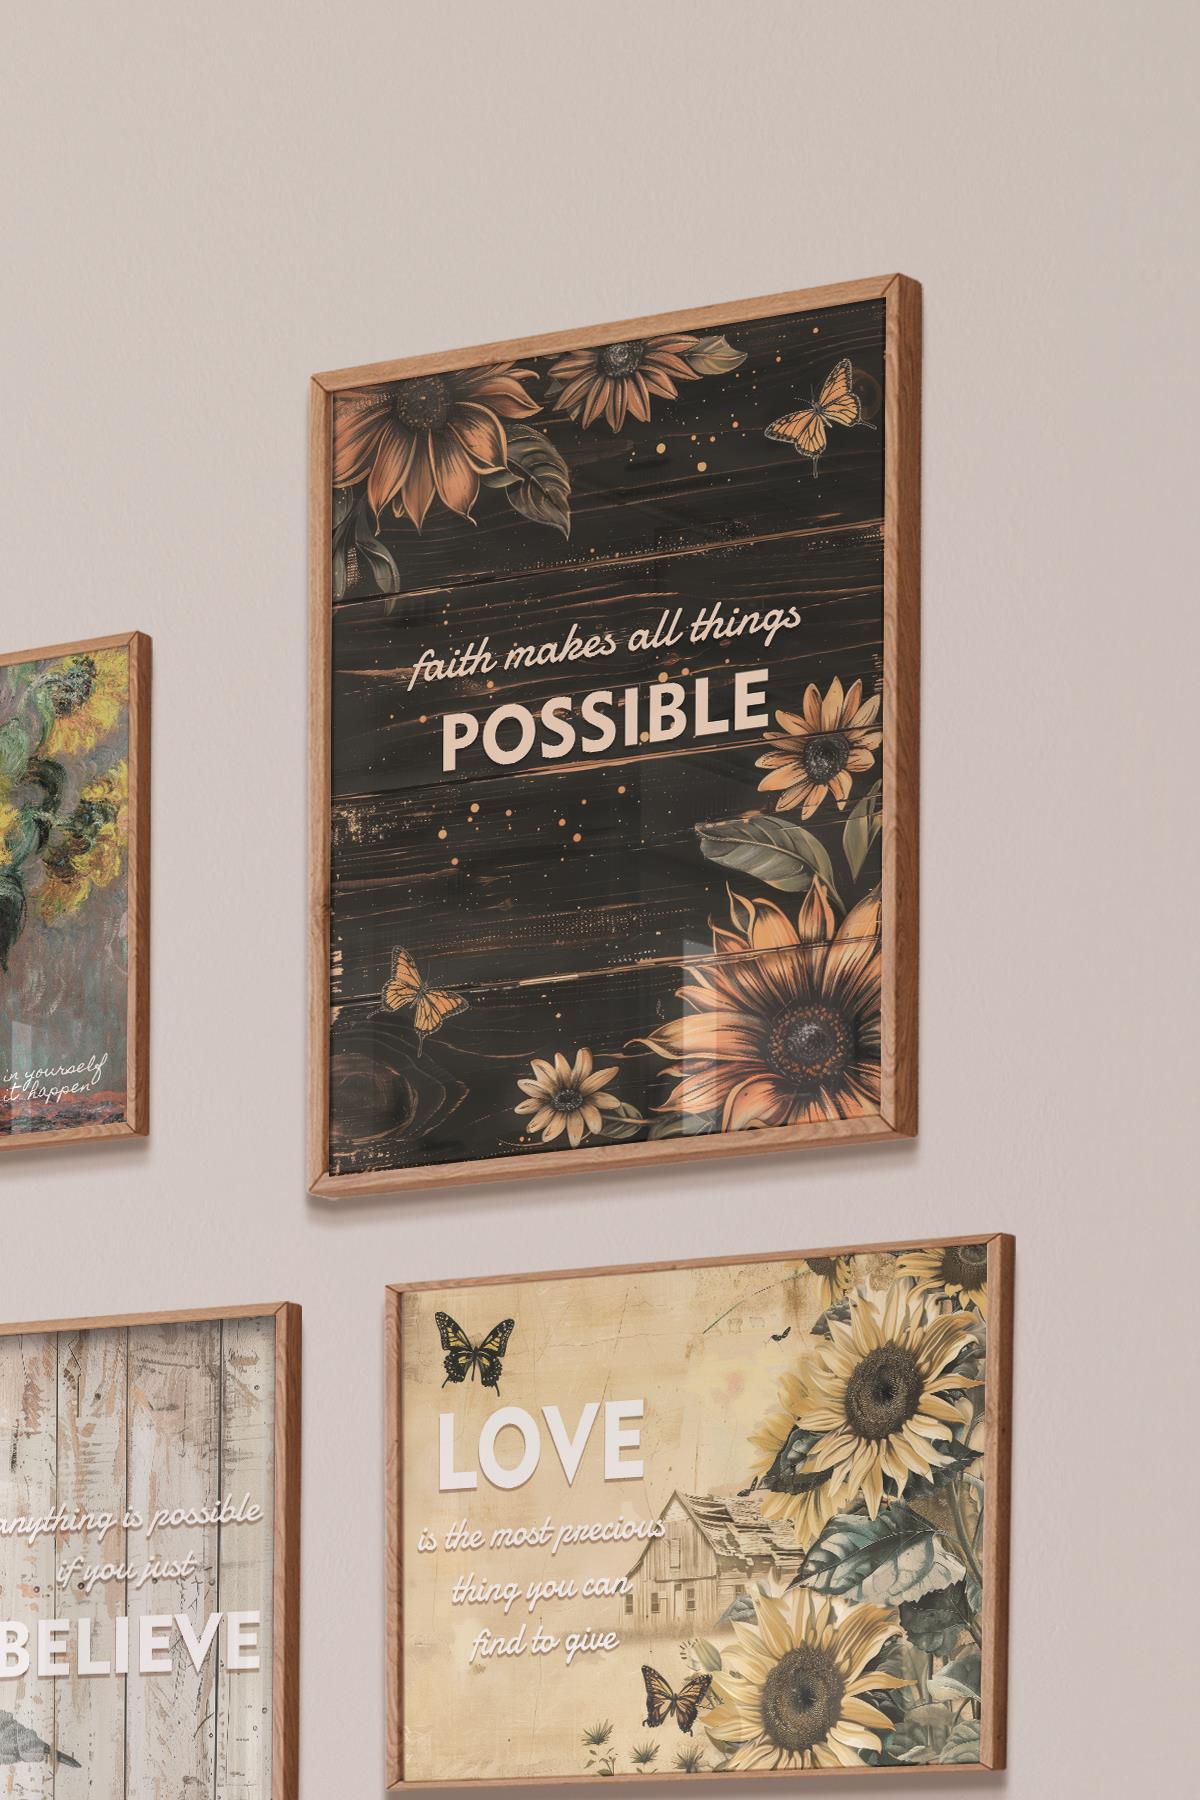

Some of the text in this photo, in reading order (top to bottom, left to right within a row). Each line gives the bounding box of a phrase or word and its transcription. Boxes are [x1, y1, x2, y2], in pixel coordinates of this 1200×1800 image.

[407, 602, 801, 691] faith makes all things
[442, 669, 769, 772] POSSIBLE
[3, 1068, 19, 1082] in
[23, 1053, 108, 1090] yourself
[0, 1084, 21, 1102] it
[27, 1083, 91, 1104] happen
[439, 1399, 644, 1491] LOVE
[122, 1503, 143, 1528] is
[146, 1492, 264, 1539] possible
[417, 1516, 666, 1556] is the most precious
[56, 1550, 199, 1593] if you just
[452, 1572, 632, 1615] thing you can
[469, 1624, 620, 1665] find to give
